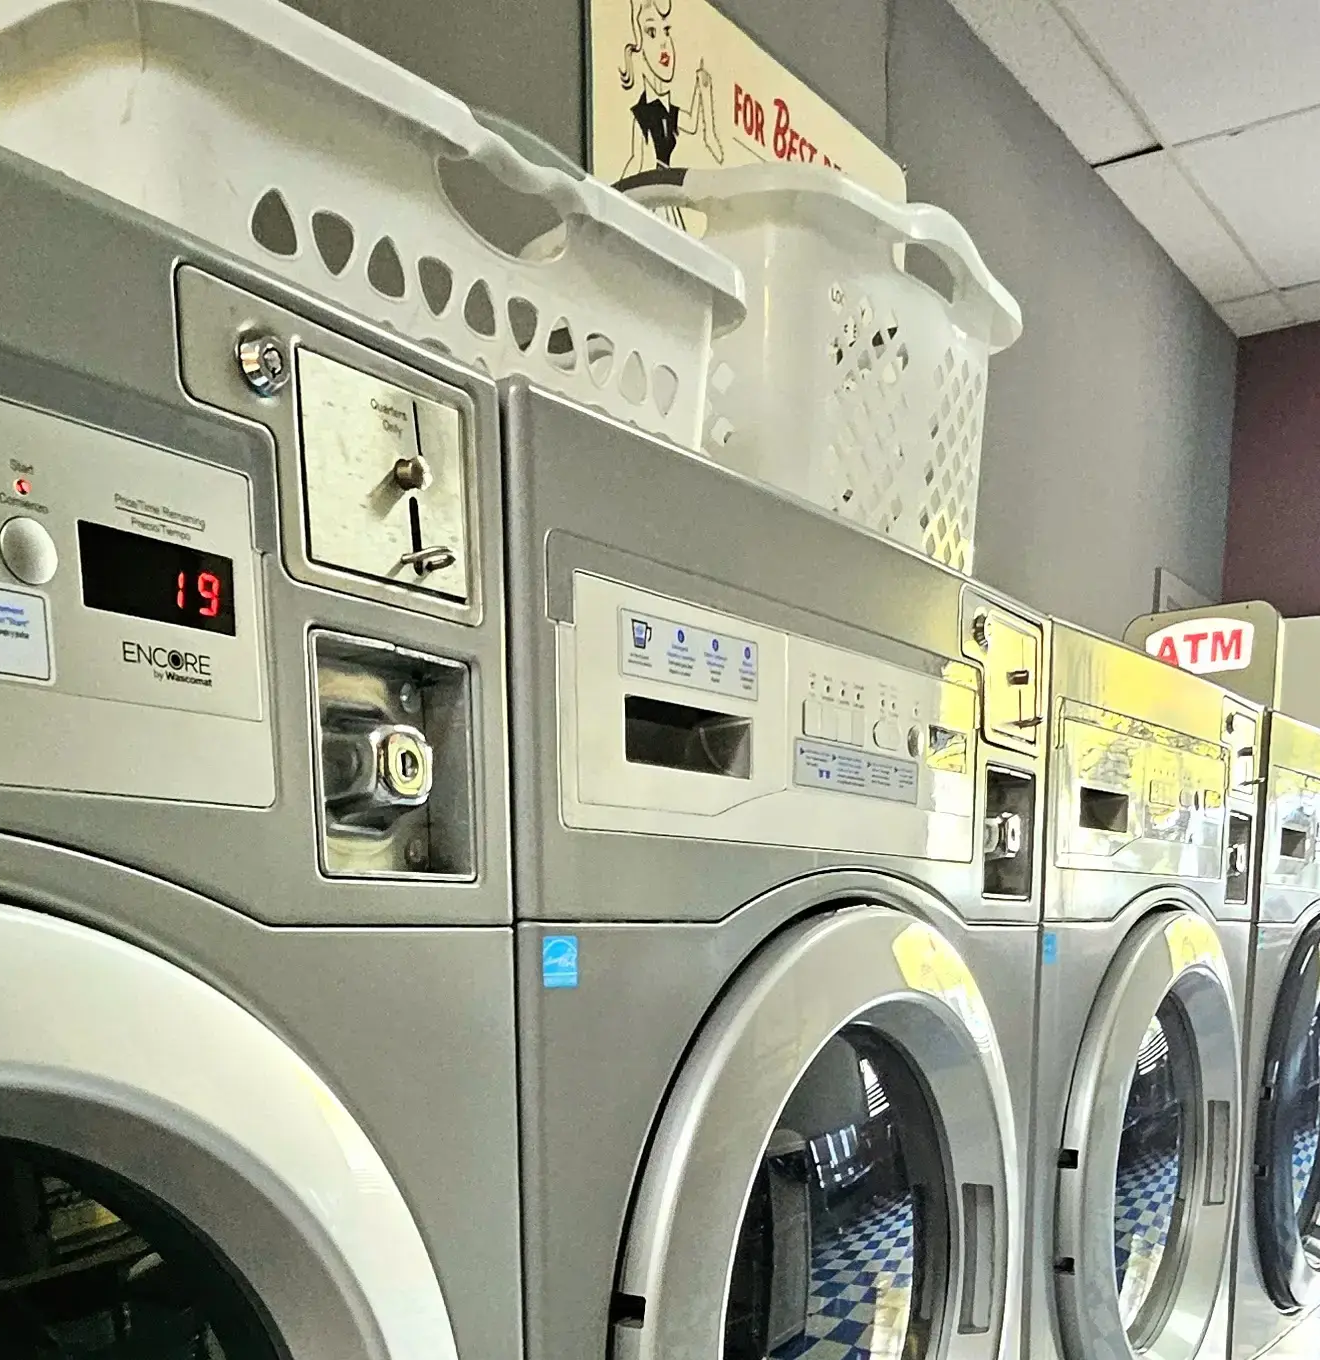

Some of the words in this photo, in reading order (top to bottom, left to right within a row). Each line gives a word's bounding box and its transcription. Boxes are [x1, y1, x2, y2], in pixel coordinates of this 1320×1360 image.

[734, 83, 766, 147] FOR
[370, 398, 408, 421] Quarters
[382, 419, 403, 439] Only
[9, 458, 34, 475] Start
[176, 571, 221, 618] 19
[122, 641, 211, 676] ENCORE
[1156, 629, 1244, 669] ATM
[153, 669, 165, 681] by
[165, 671, 213, 688] Wascomat
